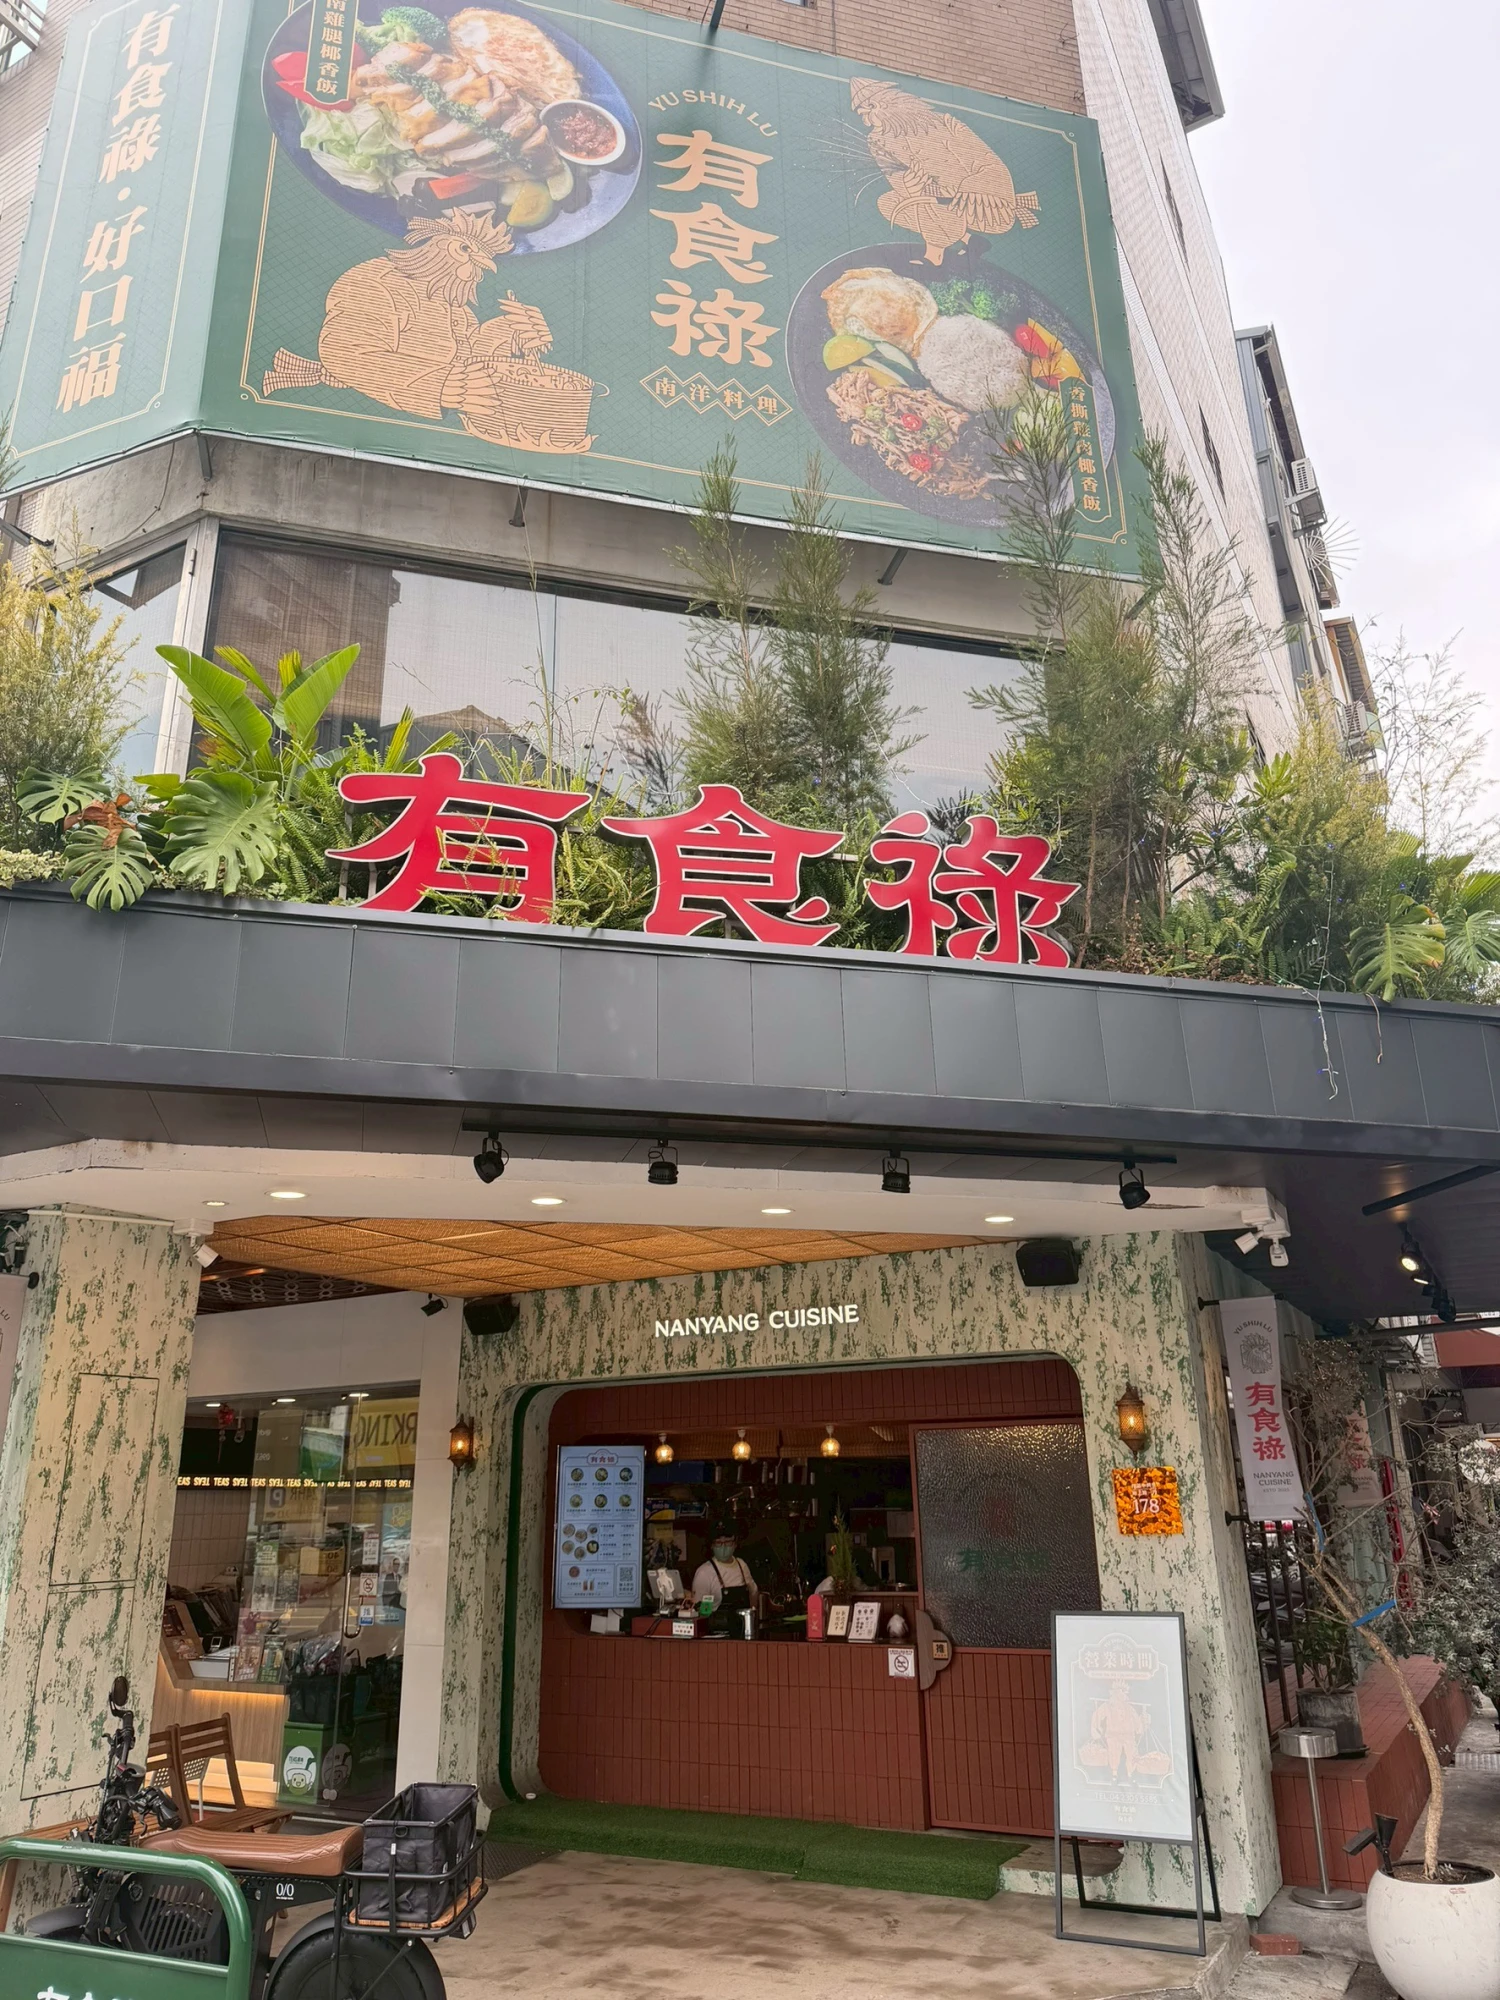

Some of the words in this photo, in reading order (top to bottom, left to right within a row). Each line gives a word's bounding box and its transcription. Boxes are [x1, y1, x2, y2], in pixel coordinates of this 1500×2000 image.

[648, 91, 680, 111] YU
[682, 89, 746, 115] SHIH
[746, 111, 778, 137] LU
[649, 128, 781, 369] 有食祿
[655, 376, 778, 416] 南洋料理
[324, 751, 1083, 968] 有食祿
[654, 1311, 760, 1338] NANYANG
[768, 1303, 860, 1331] CUISINE
[1233, 1325, 1243, 1334] YU
[1243, 1320, 1263, 1328] SHIH
[1263, 1323, 1273, 1332] LU
[1245, 1381, 1286, 1461] 有食祿
[213, 1477, 230, 1487] TEAS
[1253, 1471, 1294, 1479] NANYANG
[1258, 1478, 1292, 1486] CUISINE
[1134, 1498, 1160, 1514] 178
[1084, 1651, 1152, 1670] 營業時間
